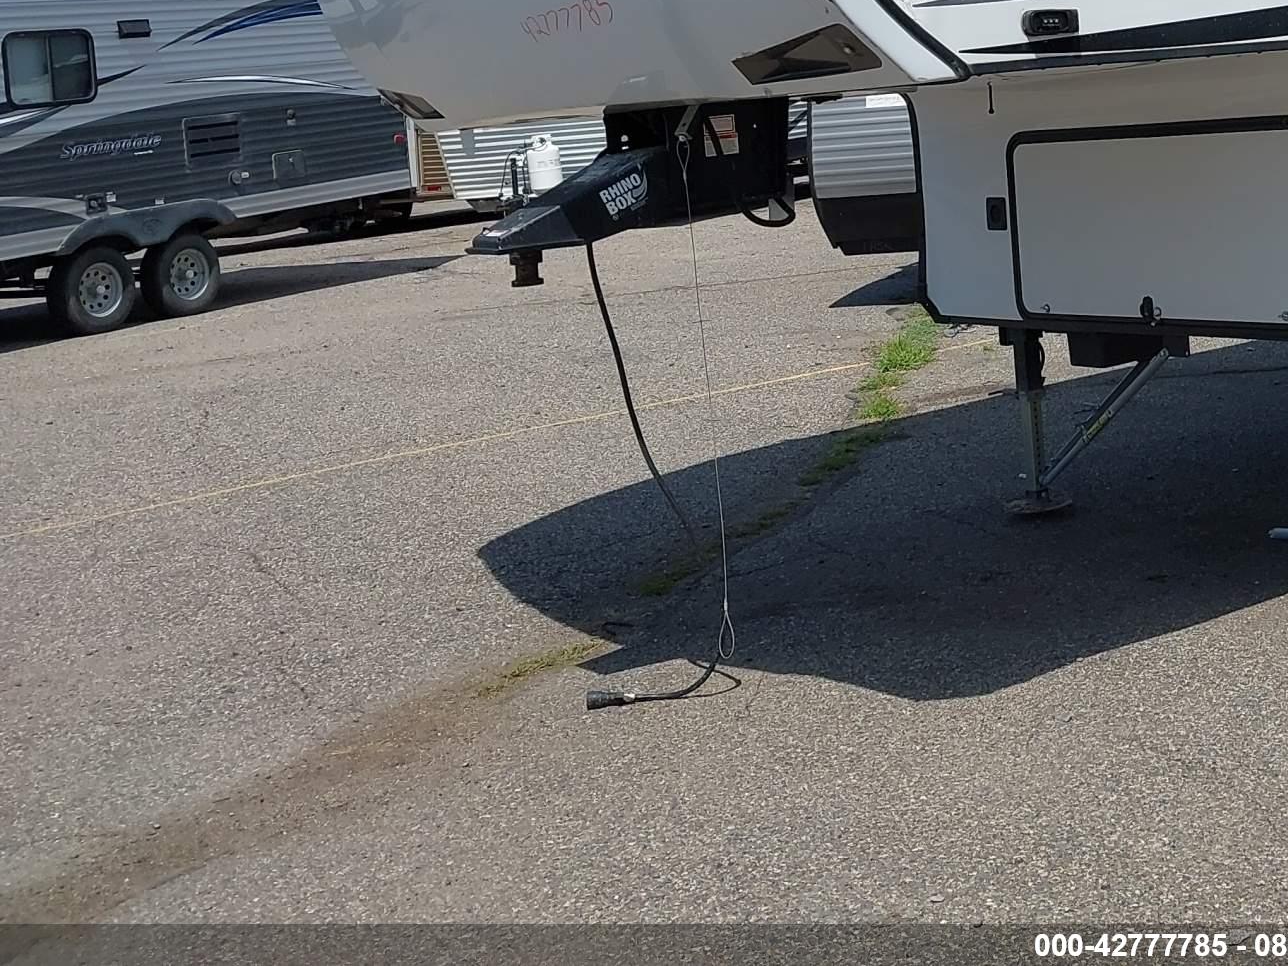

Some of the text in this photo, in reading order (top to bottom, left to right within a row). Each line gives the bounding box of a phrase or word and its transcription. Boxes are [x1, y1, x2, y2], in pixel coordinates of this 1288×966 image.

[60, 131, 162, 162] Springdale
[599, 173, 642, 204] RHINO
[605, 190, 637, 216] BOX
